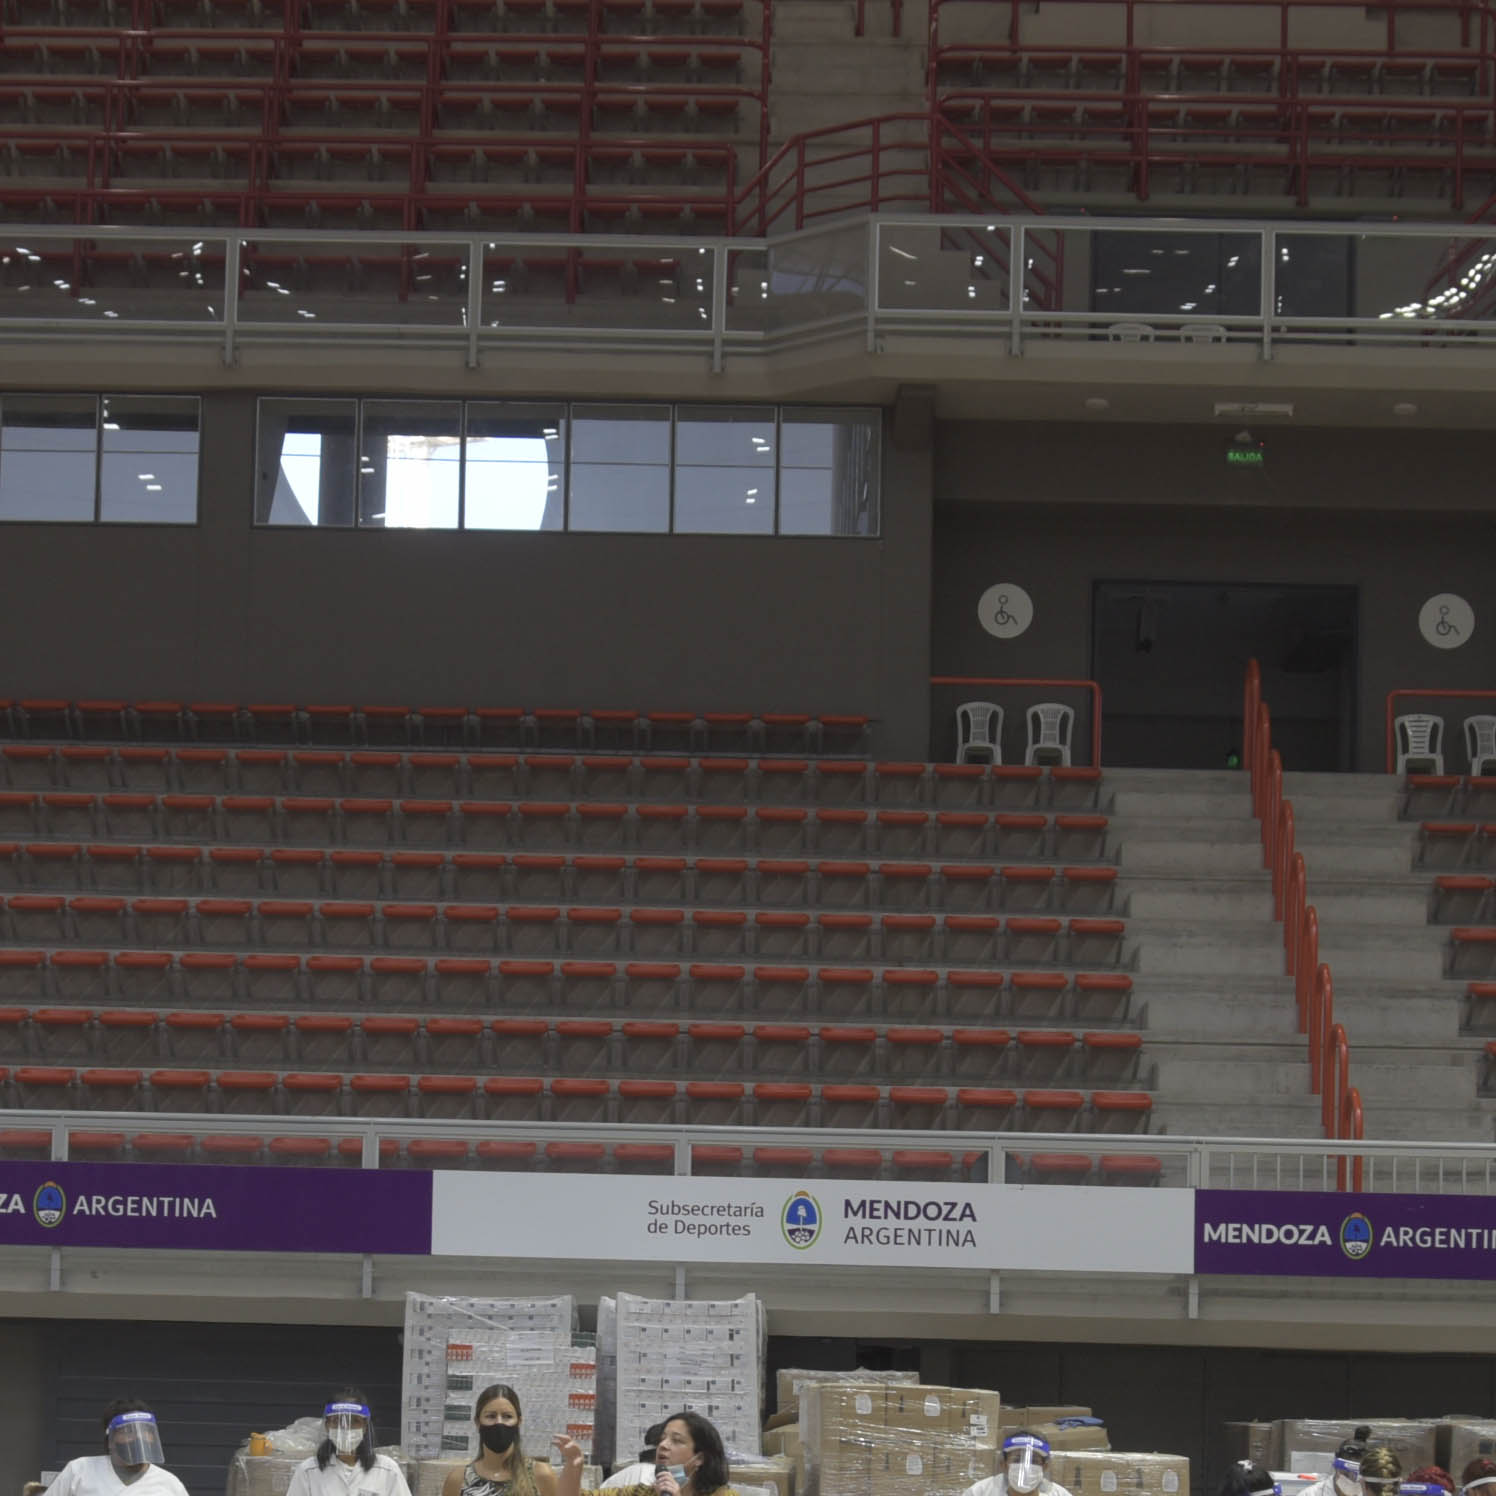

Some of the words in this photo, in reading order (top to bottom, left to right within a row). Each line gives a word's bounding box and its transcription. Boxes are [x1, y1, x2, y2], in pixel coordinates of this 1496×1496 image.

[73, 1196, 216, 1218] ARGENTINA
[648, 1199, 765, 1218] Subsecretaría
[844, 1199, 977, 1222] MENDOZA
[648, 1218, 668, 1234] de
[675, 1220, 751, 1239] Deportes
[844, 1226, 977, 1248] ARGENTINA
[1204, 1223, 1332, 1246] MENDOZA
